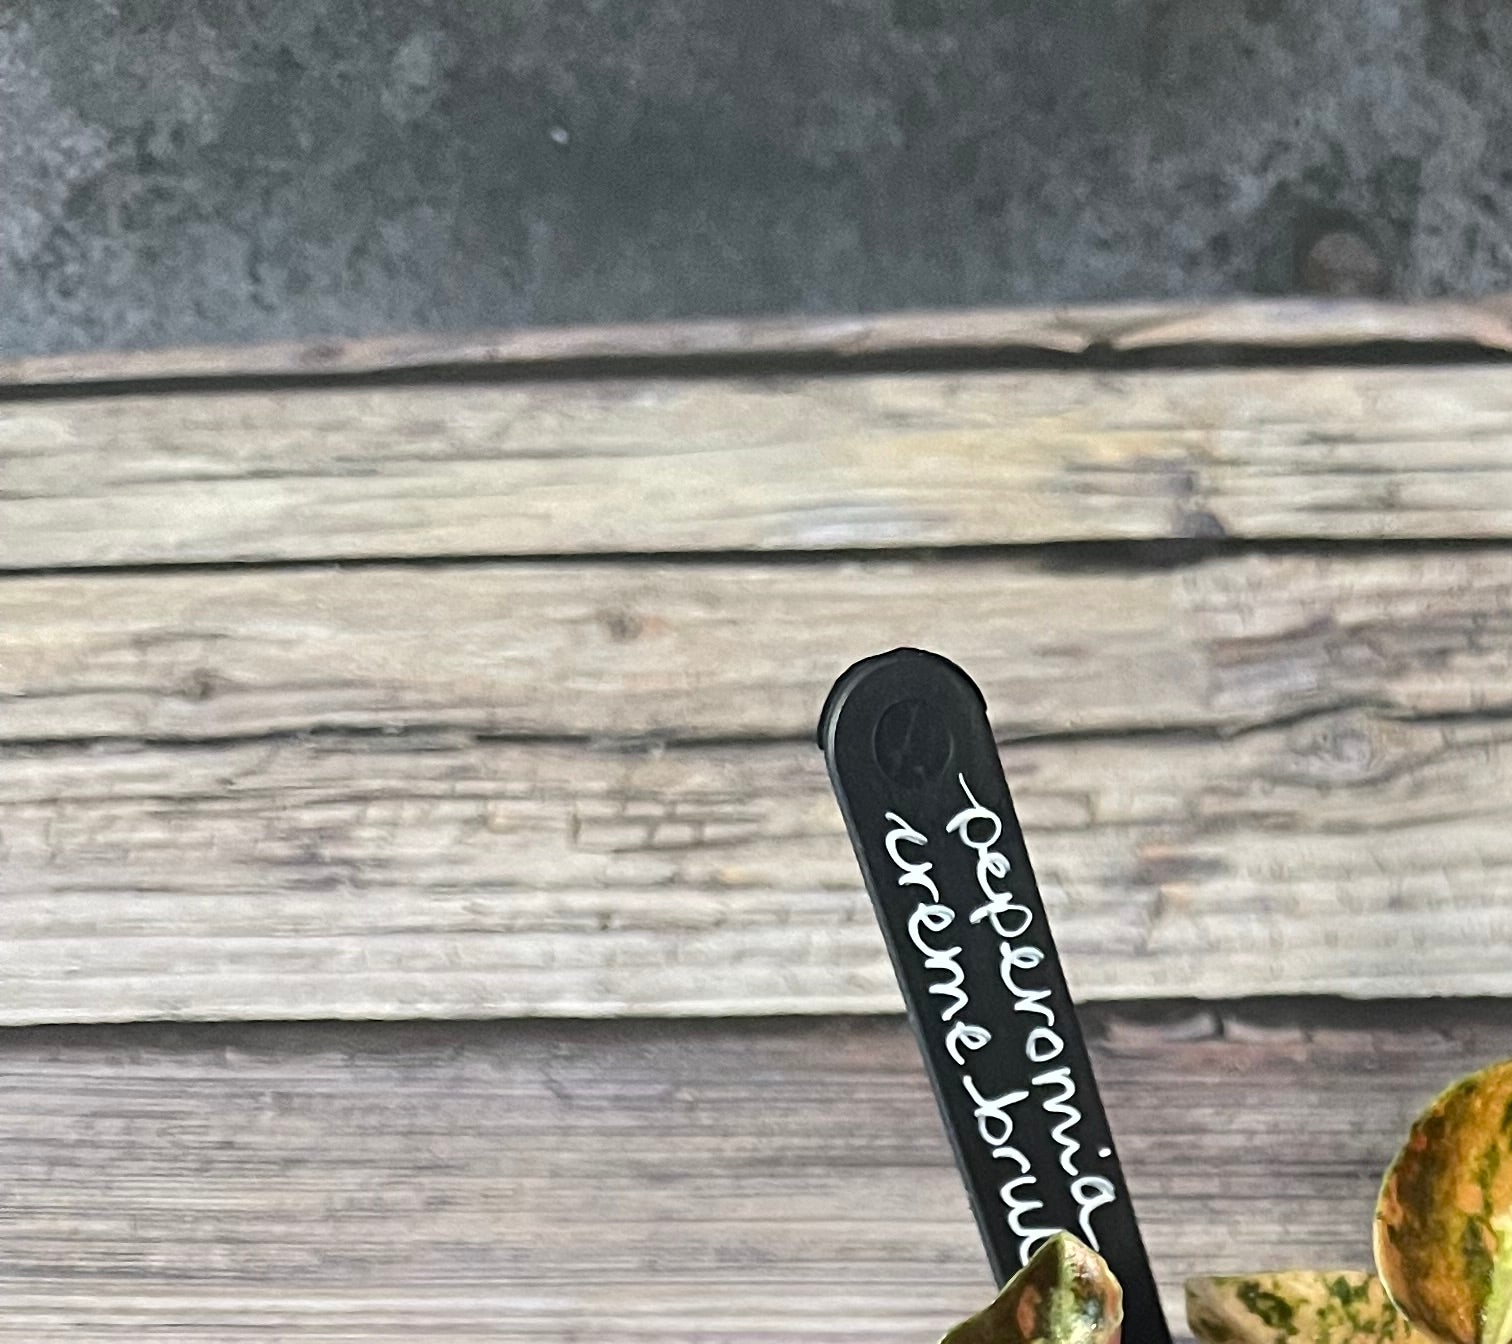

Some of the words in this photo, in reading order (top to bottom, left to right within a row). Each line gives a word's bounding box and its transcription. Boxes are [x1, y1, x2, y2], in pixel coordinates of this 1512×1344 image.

[884, 811, 992, 1066] creme
[963, 1074, 1066, 1267] brul
[945, 772, 1116, 1252] peperomia
